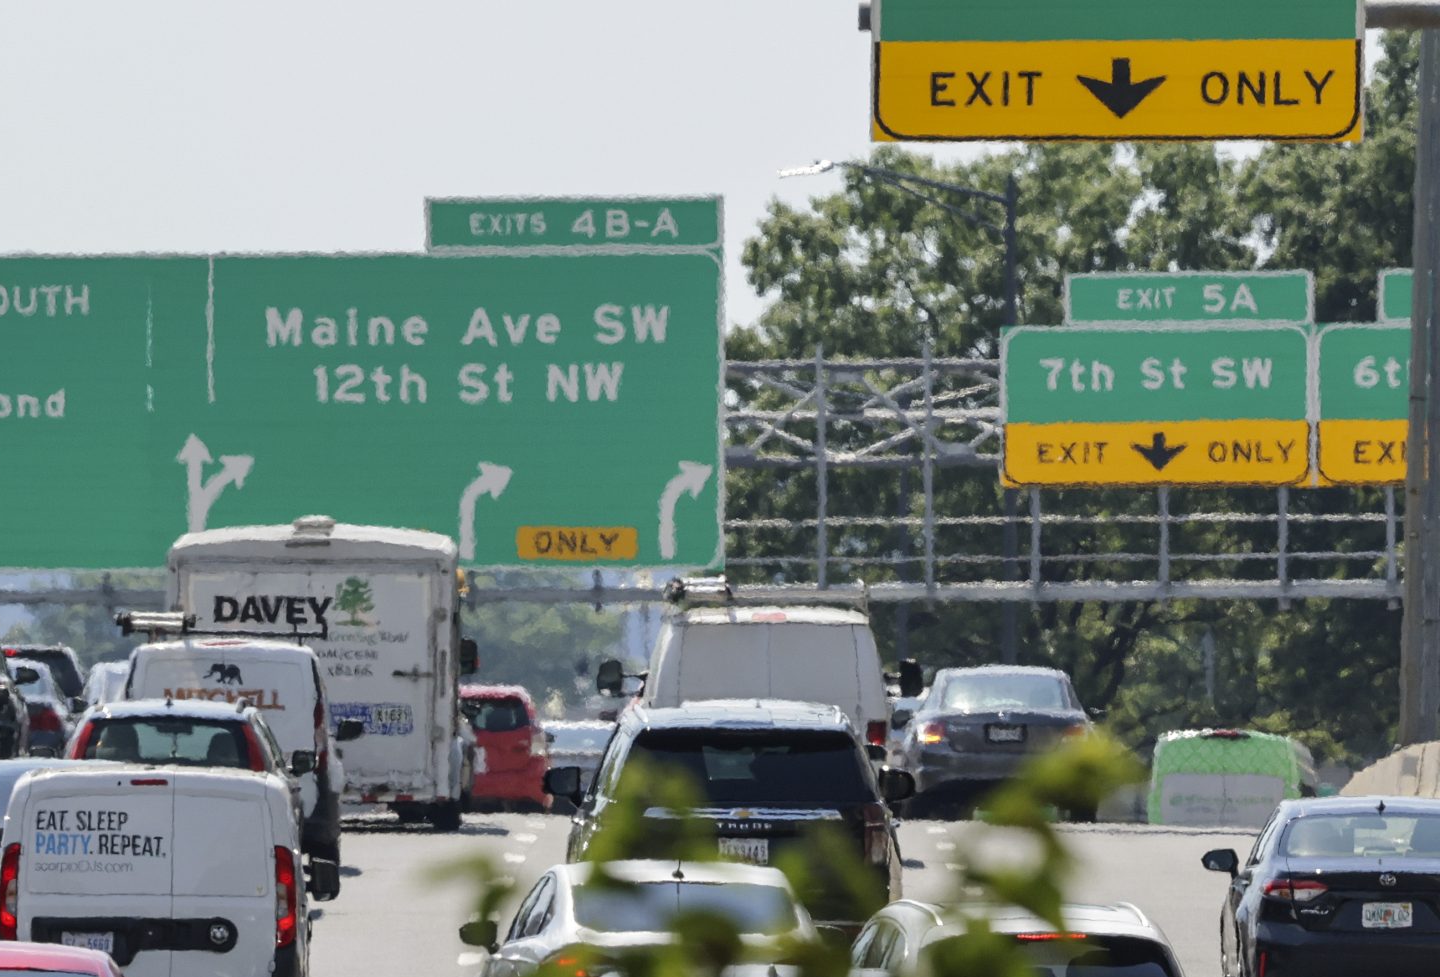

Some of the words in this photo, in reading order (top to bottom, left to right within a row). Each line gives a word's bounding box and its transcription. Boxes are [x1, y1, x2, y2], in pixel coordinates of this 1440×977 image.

[929, 71, 1043, 107] EXIT
[1200, 70, 1336, 107] ONLY
[468, 212, 547, 235] EXITS
[570, 208, 680, 239] 4B-A
[1116, 287, 1176, 311] EXIT
[1201, 283, 1259, 314] 5A
[264, 305, 429, 347] Maine
[460, 306, 562, 347] Ave
[592, 303, 671, 345] SW
[313, 363, 429, 405] 12th
[458, 363, 514, 405] St
[545, 361, 625, 405] NW
[1038, 356, 1116, 392] 7th
[1139, 355, 1189, 391] St
[1210, 356, 1274, 390] SW
[1352, 355, 1410, 388] 6t
[1035, 441, 1109, 464] EXIT
[1207, 439, 1297, 464] ONLY
[1352, 440, 1407, 465] EXI
[533, 530, 620, 555] ONLY
[213, 595, 334, 624] DAVEY
[75, 810, 129, 832] SLEEP
